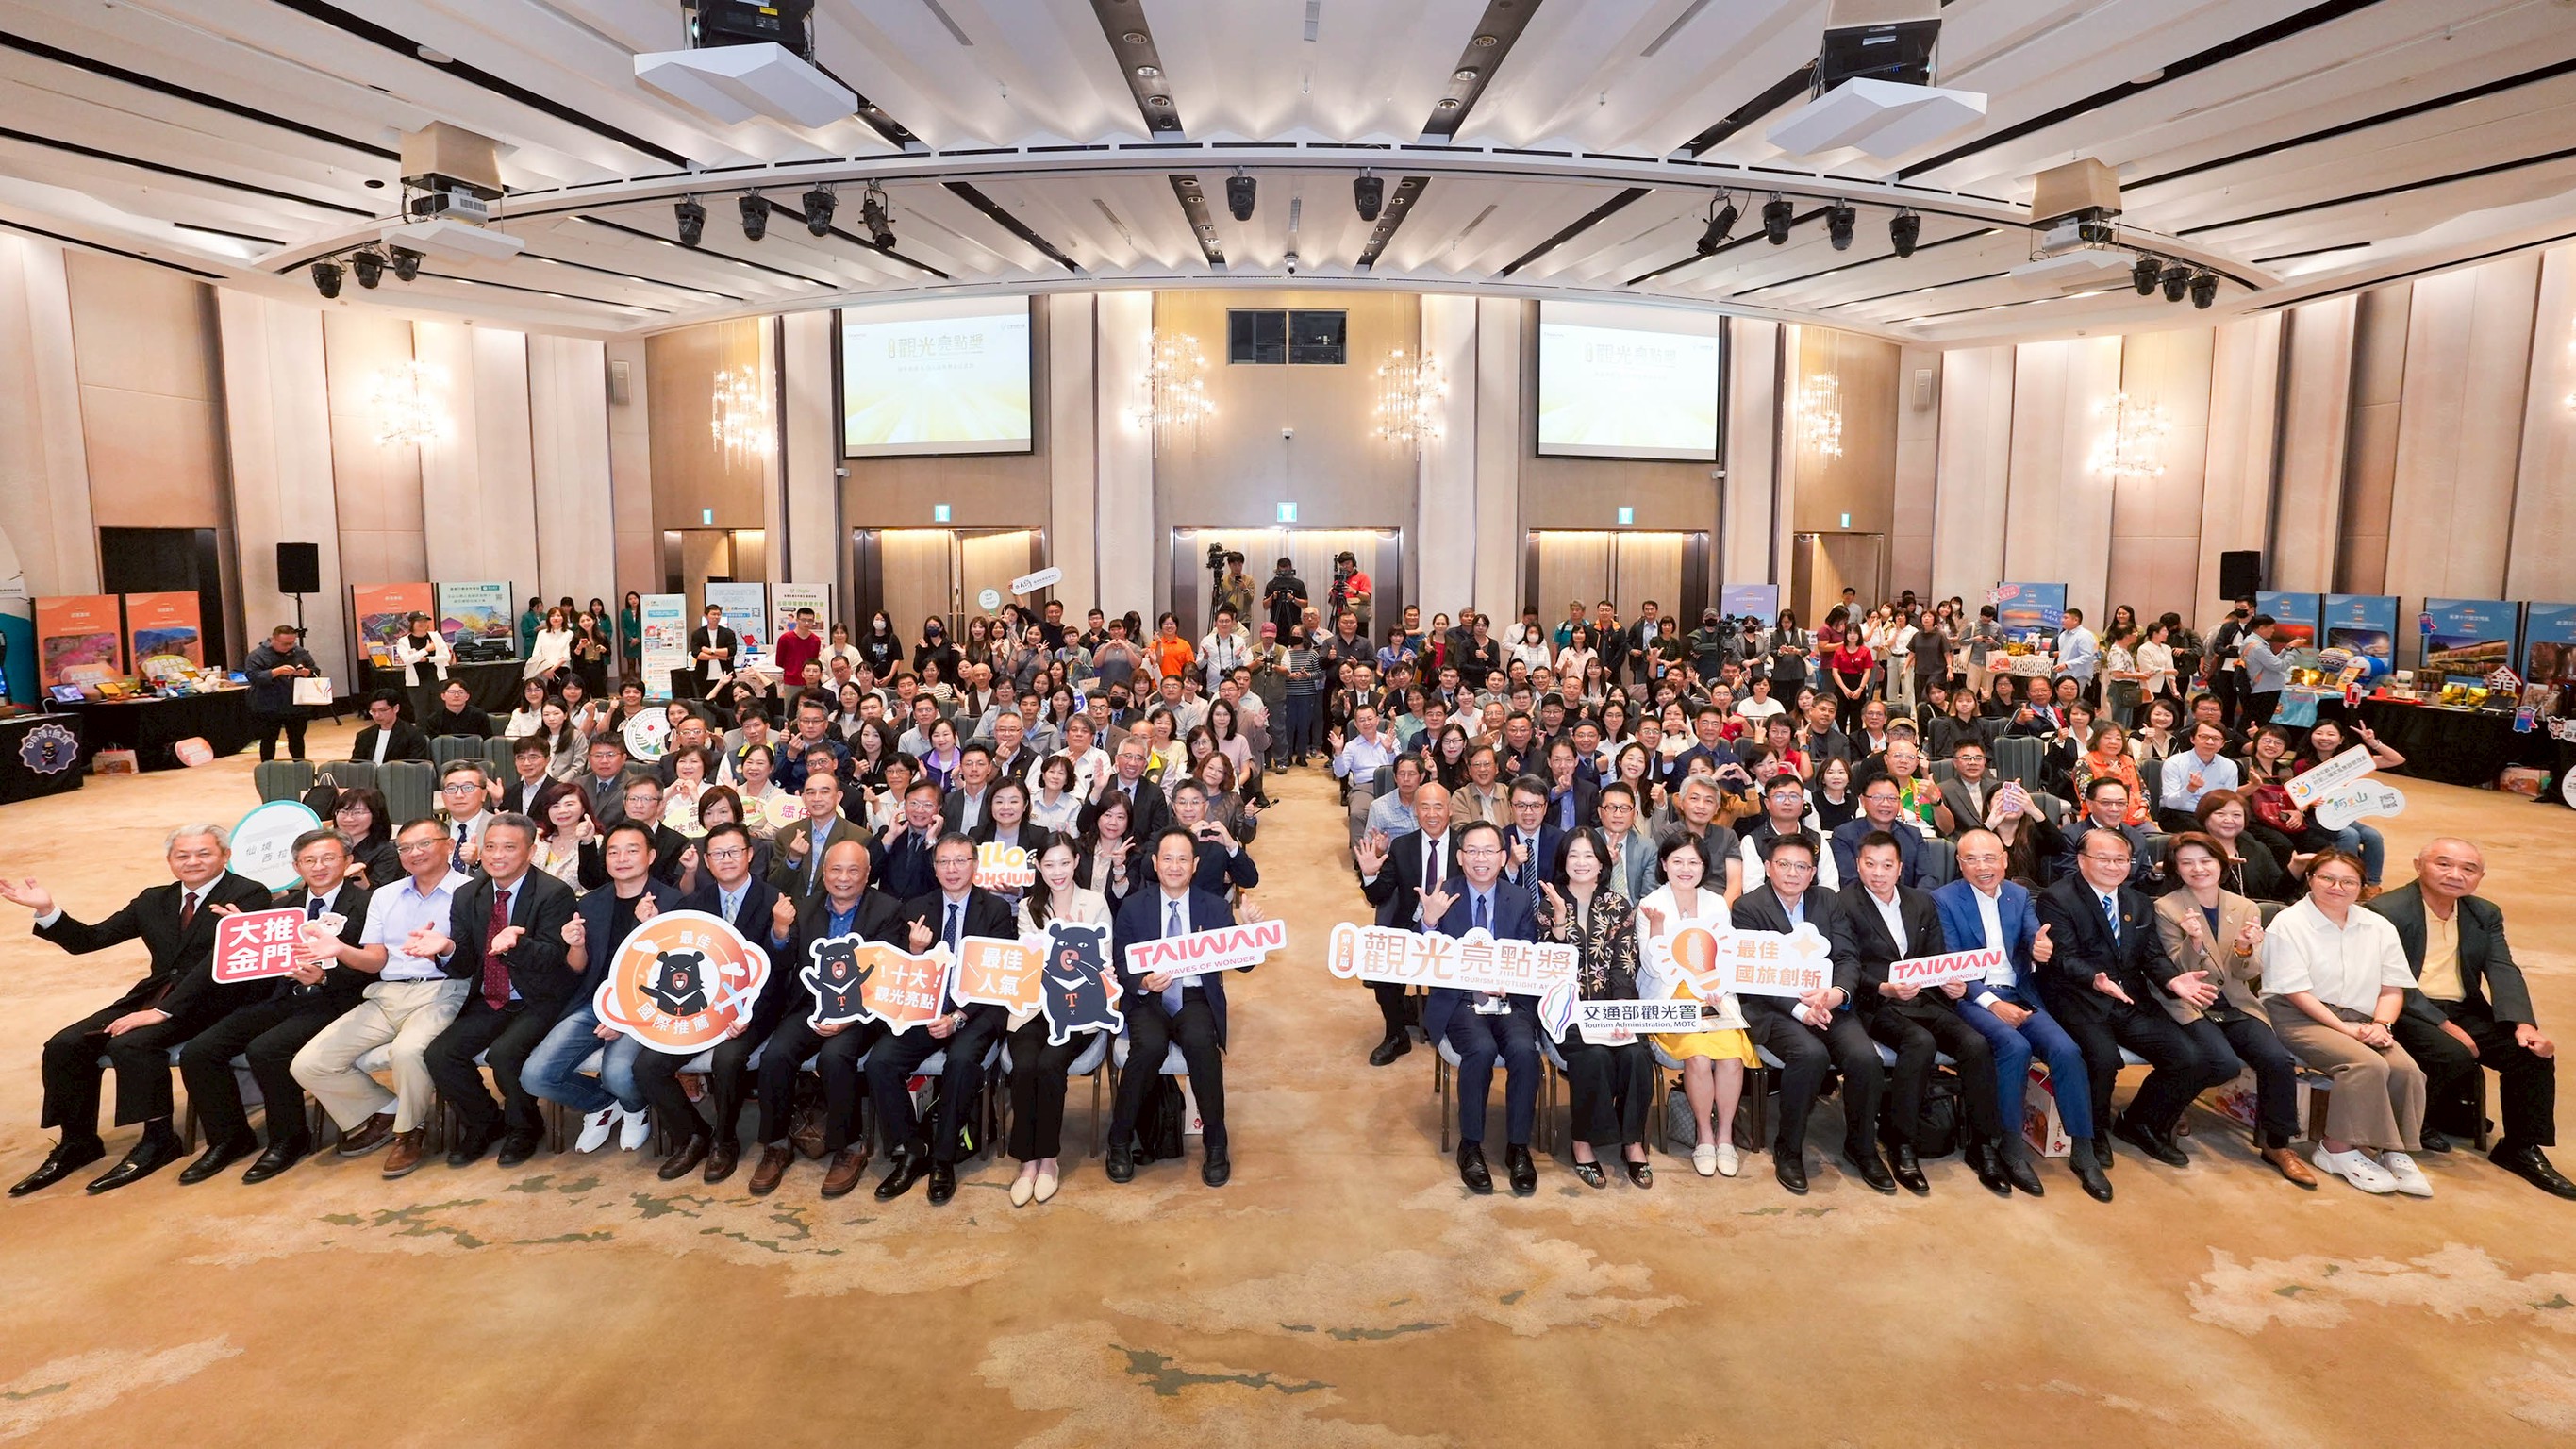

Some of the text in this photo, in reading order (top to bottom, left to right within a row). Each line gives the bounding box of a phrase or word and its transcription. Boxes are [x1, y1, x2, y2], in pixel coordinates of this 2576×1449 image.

[977, 842, 1025, 867] LLO
[972, 872, 1036, 885] OHSIUN
[228, 915, 295, 948] 大推
[679, 930, 712, 948] 最佳
[225, 942, 292, 974] 金門
[1130, 924, 1282, 968] TAIWAN
[1363, 932, 1571, 980] 觀光亮點獎
[1737, 940, 1779, 960] 最佳
[980, 946, 1024, 972] 最佳
[1166, 965, 1198, 976] WAVES
[1214, 955, 1255, 968] WONDER
[1894, 950, 2002, 980] TAIWAN
[977, 974, 1021, 998] 人氣
[1460, 975, 1495, 984] TOURISM
[1496, 978, 1537, 990] SPOTLIGHT
[1736, 965, 1822, 989] 國旅創新
[874, 985, 936, 1010] 觀光亮點
[1583, 1004, 1697, 1021] 交通部觀光署
[1615, 1021, 1673, 1029] Administration,
